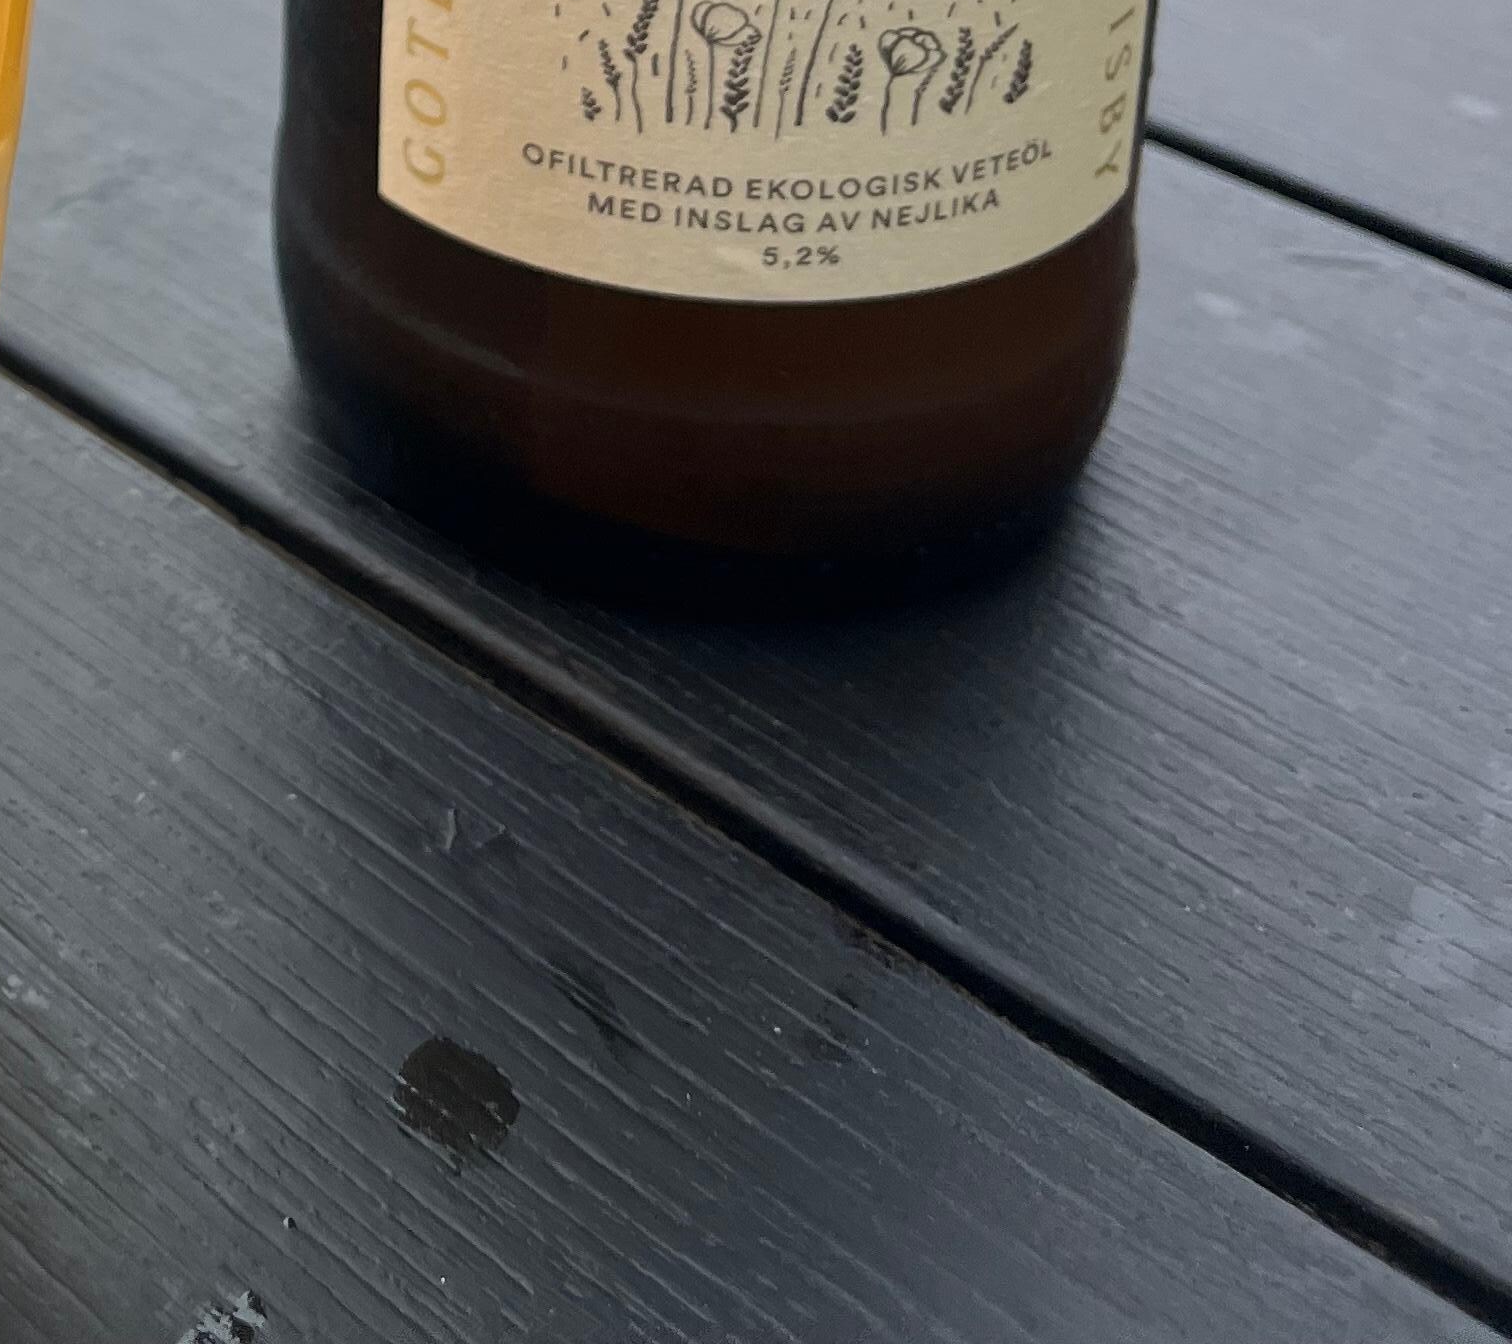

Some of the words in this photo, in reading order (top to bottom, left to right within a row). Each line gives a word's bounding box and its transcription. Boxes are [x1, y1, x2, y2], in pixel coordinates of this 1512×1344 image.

[521, 141, 734, 198] OFILTRERAD
[746, 167, 942, 201] EKOLOGISK
[950, 138, 1054, 185] VETEÖL
[587, 192, 662, 224] MED
[674, 206, 804, 234] INSLAG
[816, 208, 860, 233] AV
[872, 187, 1001, 230] NEJLIKA
[761, 244, 840, 268] 5,2%
